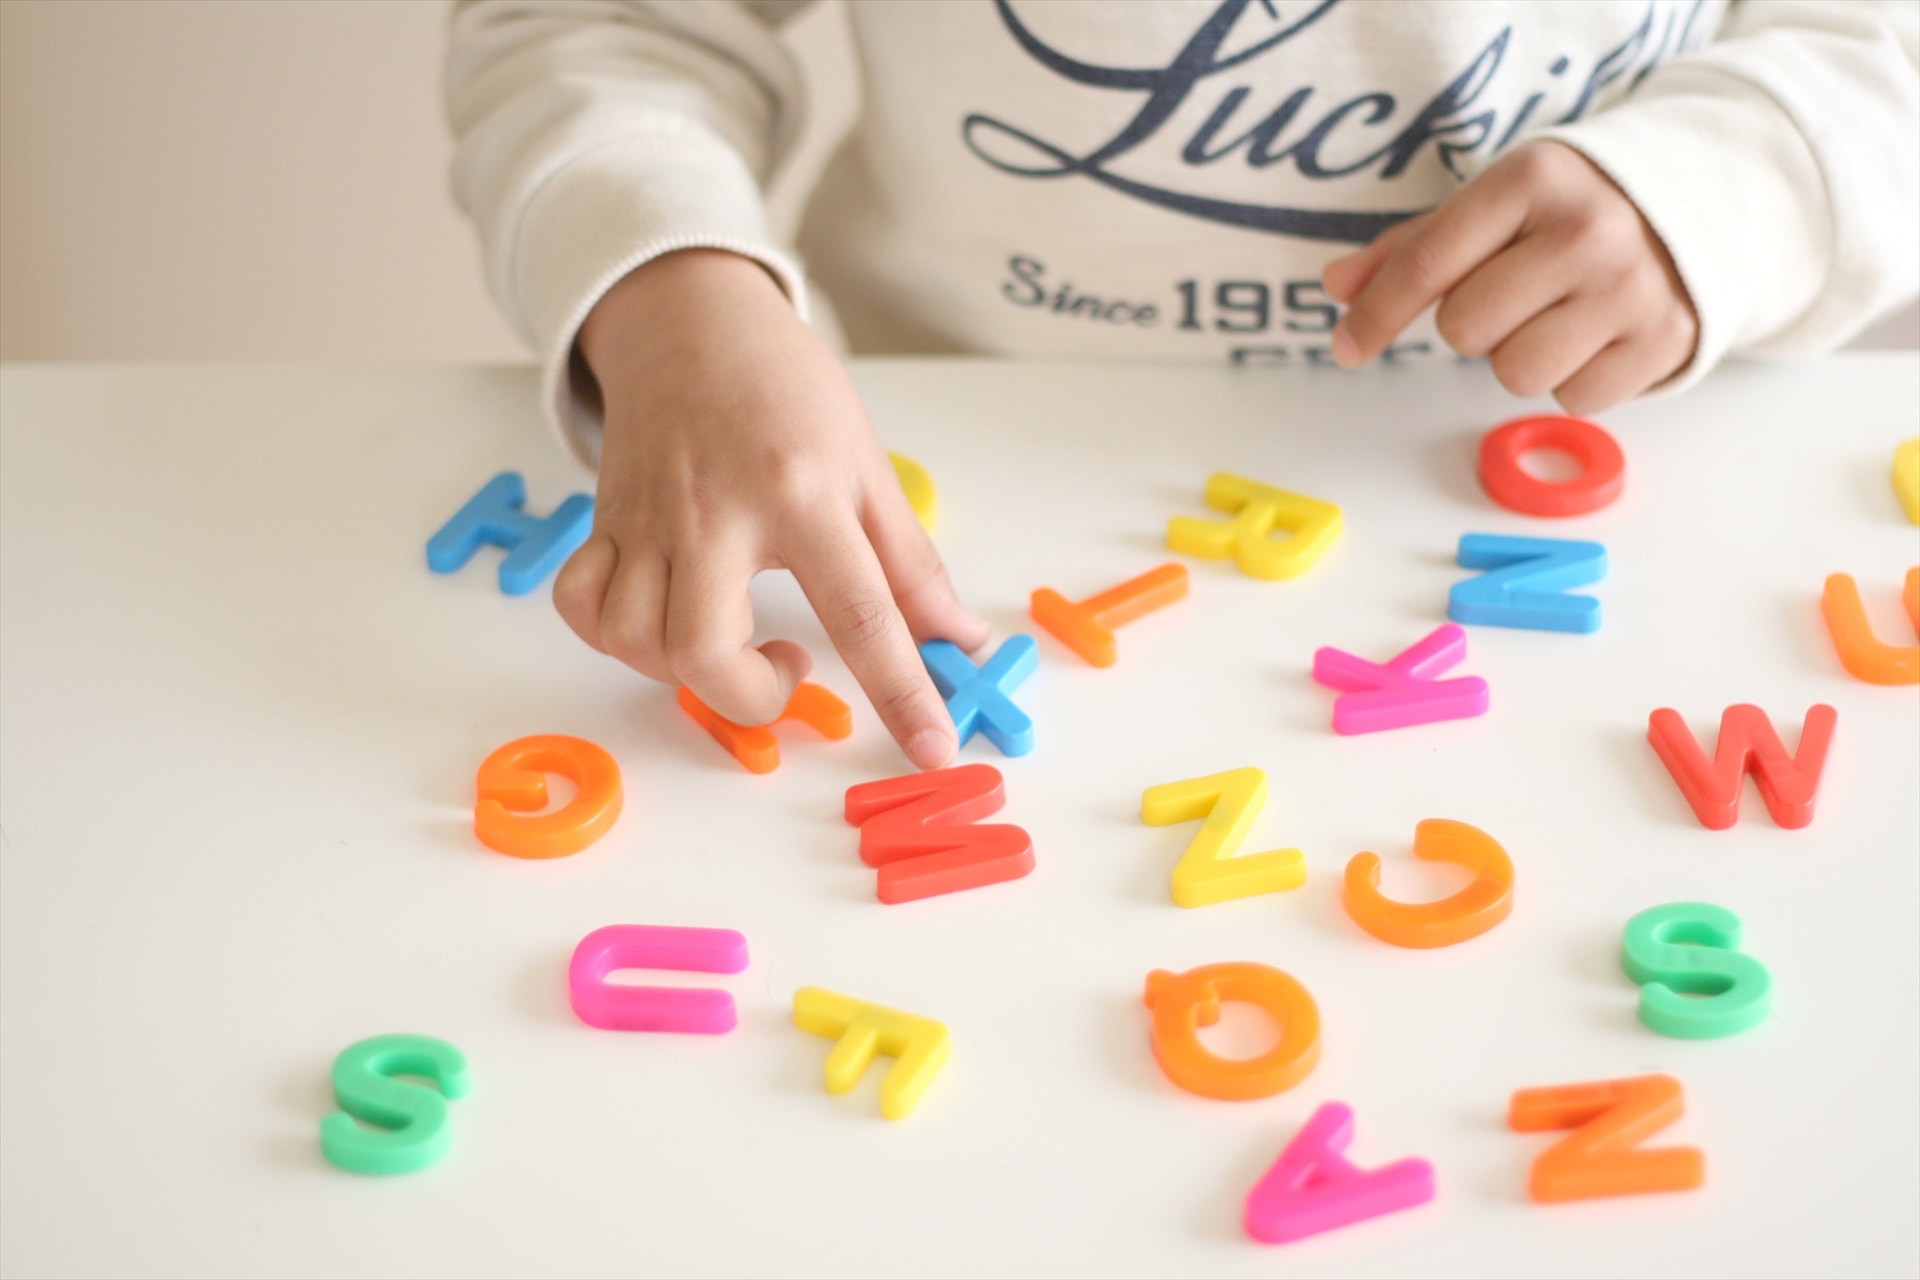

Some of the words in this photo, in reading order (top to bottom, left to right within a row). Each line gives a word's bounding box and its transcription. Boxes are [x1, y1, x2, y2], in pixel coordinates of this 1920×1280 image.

[964, 0, 1705, 243] Lucki
[1002, 254, 1160, 328] Since
[1174, 279, 1343, 334] 195
[426, 471, 594, 596] H
[1165, 472, 1344, 582] R
[1029, 562, 1190, 668] T
[1312, 622, 1490, 736] K
[919, 633, 1040, 758] X
[473, 733, 624, 860] G
[1647, 701, 1838, 831] W
[1342, 817, 1516, 950] C
[568, 923, 750, 1035] U
[1143, 960, 1322, 1102] Q
[1620, 901, 1773, 1040] S
[320, 1032, 470, 1177] S
[792, 985, 951, 1121] F
[1243, 1099, 1437, 1246] A
